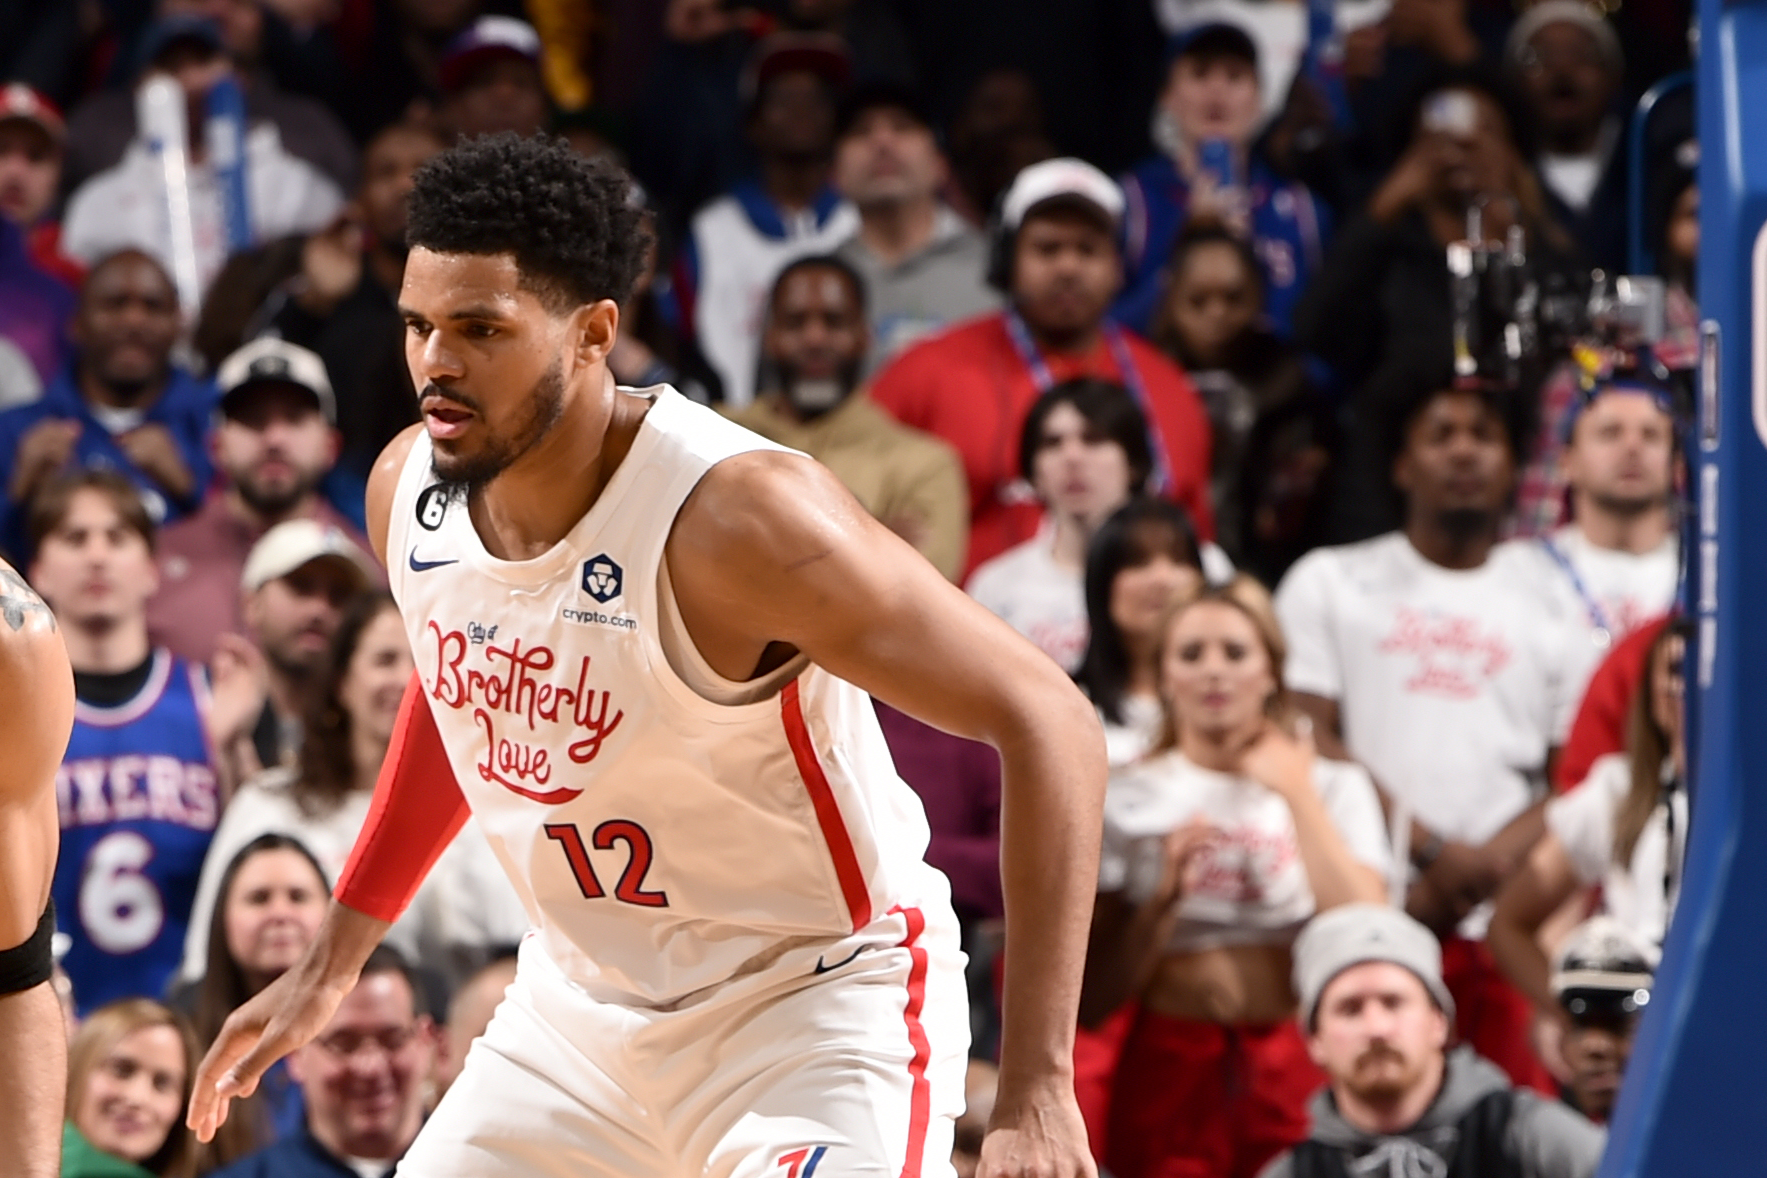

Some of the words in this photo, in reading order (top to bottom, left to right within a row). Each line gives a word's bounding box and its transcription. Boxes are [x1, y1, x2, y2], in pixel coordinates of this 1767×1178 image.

[422, 488, 447, 528] 6
[562, 606, 638, 630] crypto.com
[426, 619, 625, 765] Brotherly
[55, 754, 218, 831] IXERS
[474, 707, 585, 806] Love
[79, 829, 166, 956] 6
[544, 818, 670, 909] 12
